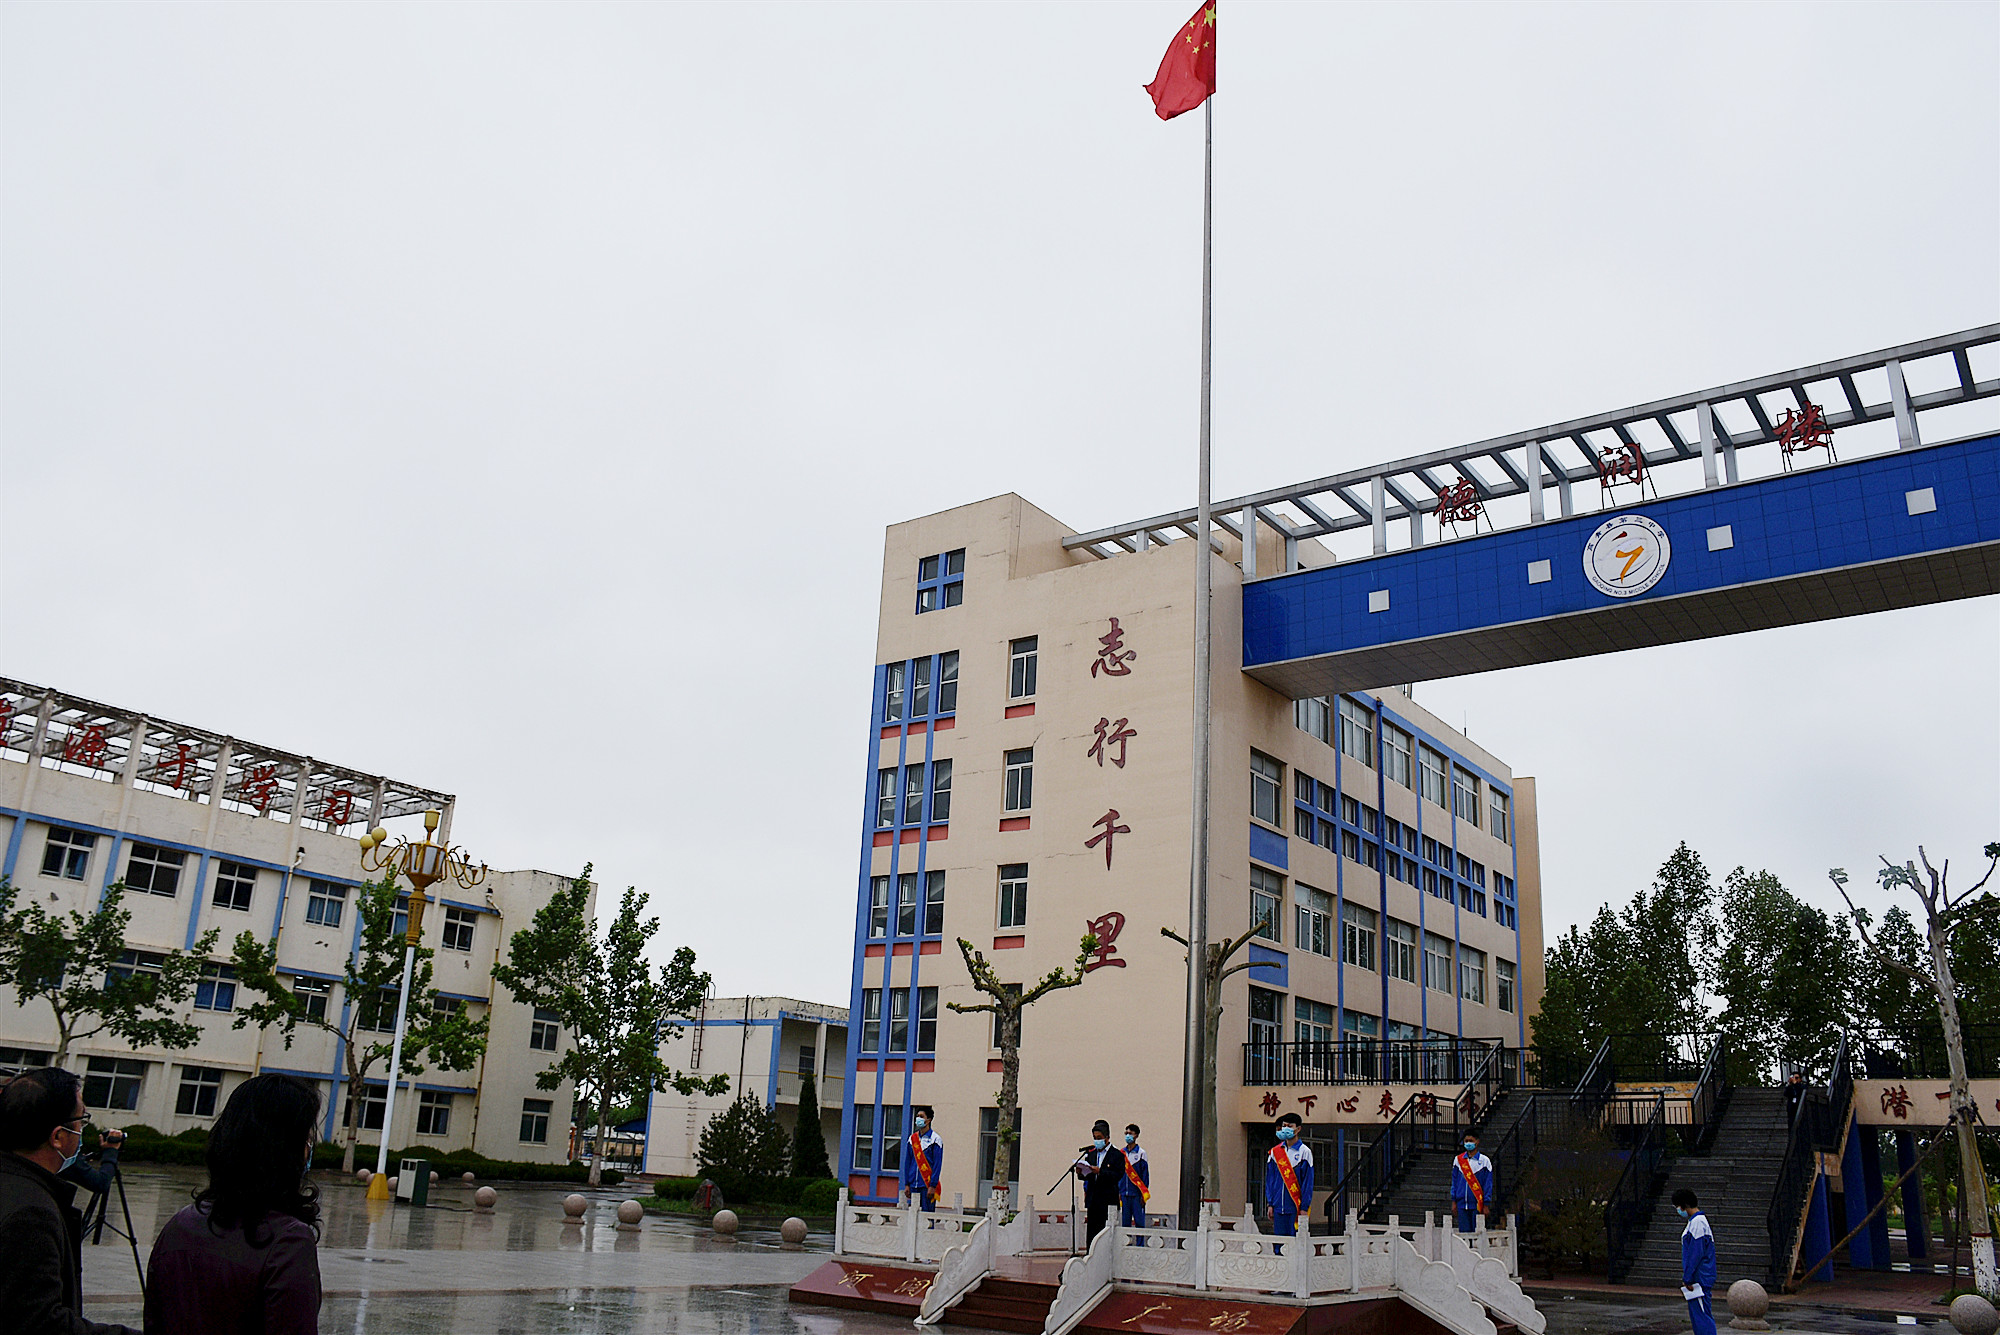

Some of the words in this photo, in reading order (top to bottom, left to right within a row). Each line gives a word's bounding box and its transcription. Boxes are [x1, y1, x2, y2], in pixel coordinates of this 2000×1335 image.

[1433, 401, 1834, 526] 德润楼
[1592, 576, 1613, 593] GAOQING
[1628, 583, 1650, 595] MIDDLE
[1649, 564, 1665, 584] SCHOOL
[1084, 617, 1138, 974] 志行千里
